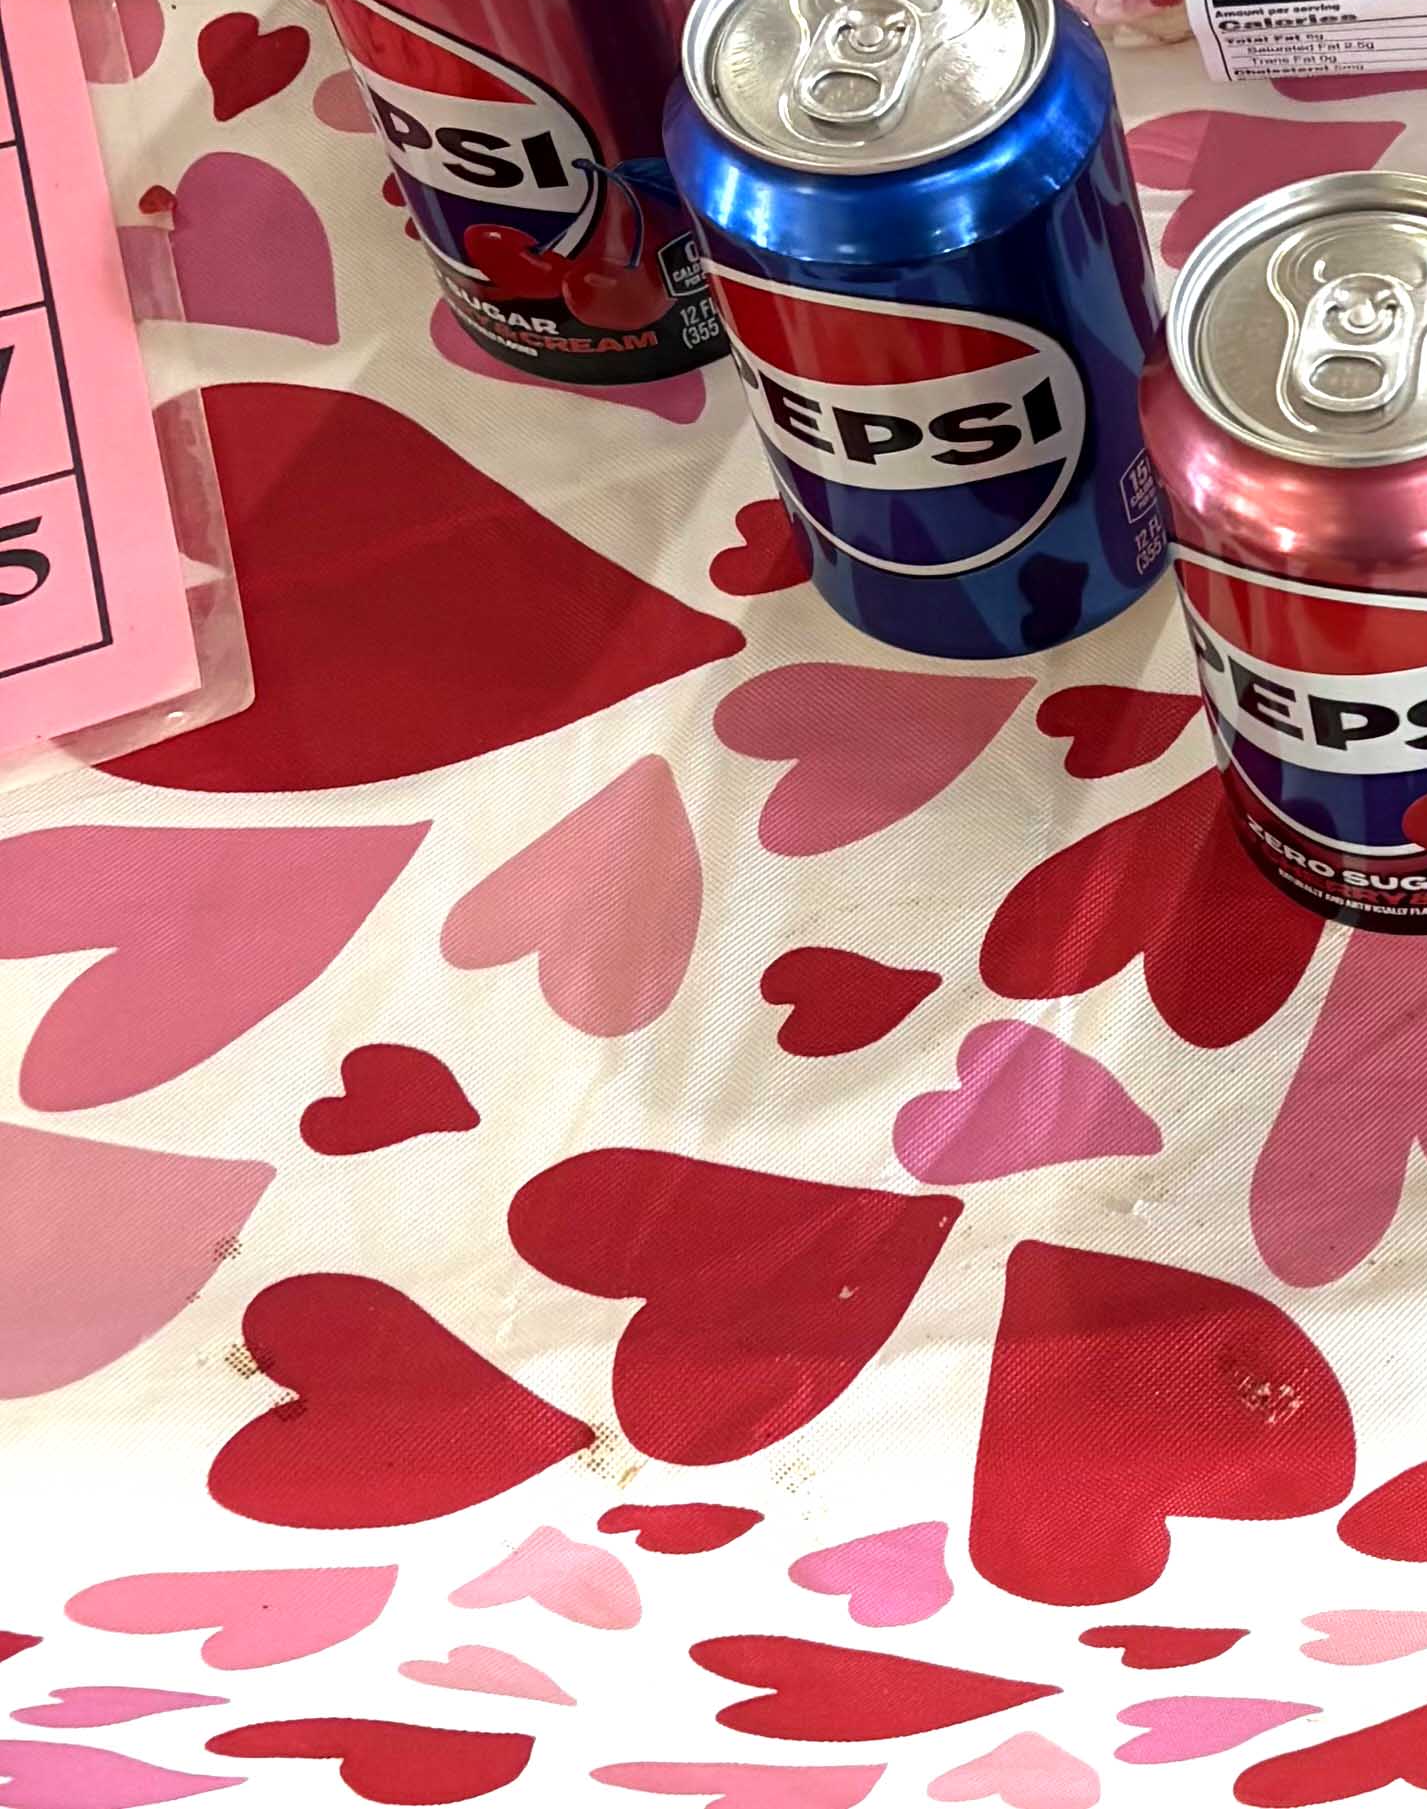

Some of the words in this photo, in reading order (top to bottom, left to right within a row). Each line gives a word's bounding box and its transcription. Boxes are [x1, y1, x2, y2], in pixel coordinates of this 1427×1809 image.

[1217, 13, 1358, 33] Calories
[366, 85, 569, 190] PSI
[679, 304, 701, 327] 12
[735, 357, 1063, 467] EPSI
[0, 516, 50, 607] 5
[1247, 813, 1336, 878] ZERO
